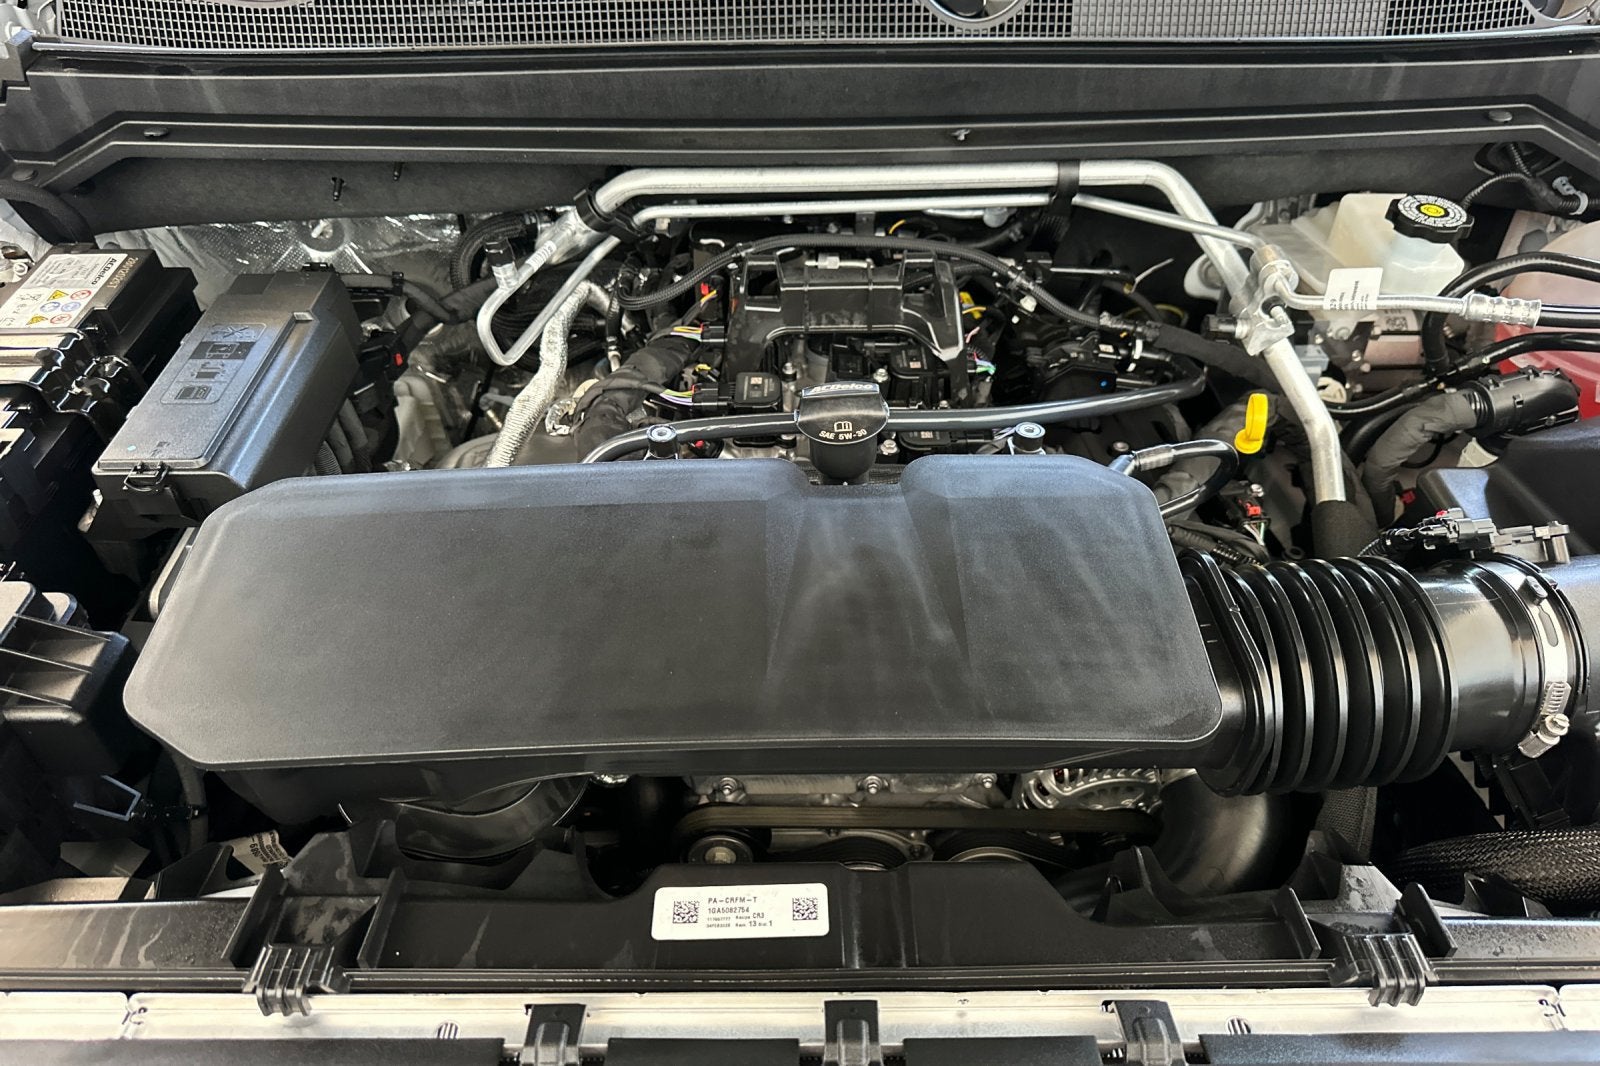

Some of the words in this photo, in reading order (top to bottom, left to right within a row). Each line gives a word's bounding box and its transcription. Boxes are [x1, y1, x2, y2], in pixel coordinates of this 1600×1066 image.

[92, 258, 117, 285] ACDelco
[810, 383, 873, 393] ACDelco
[819, 430, 835, 440] SAE
[838, 429, 868, 440] 5W-30
